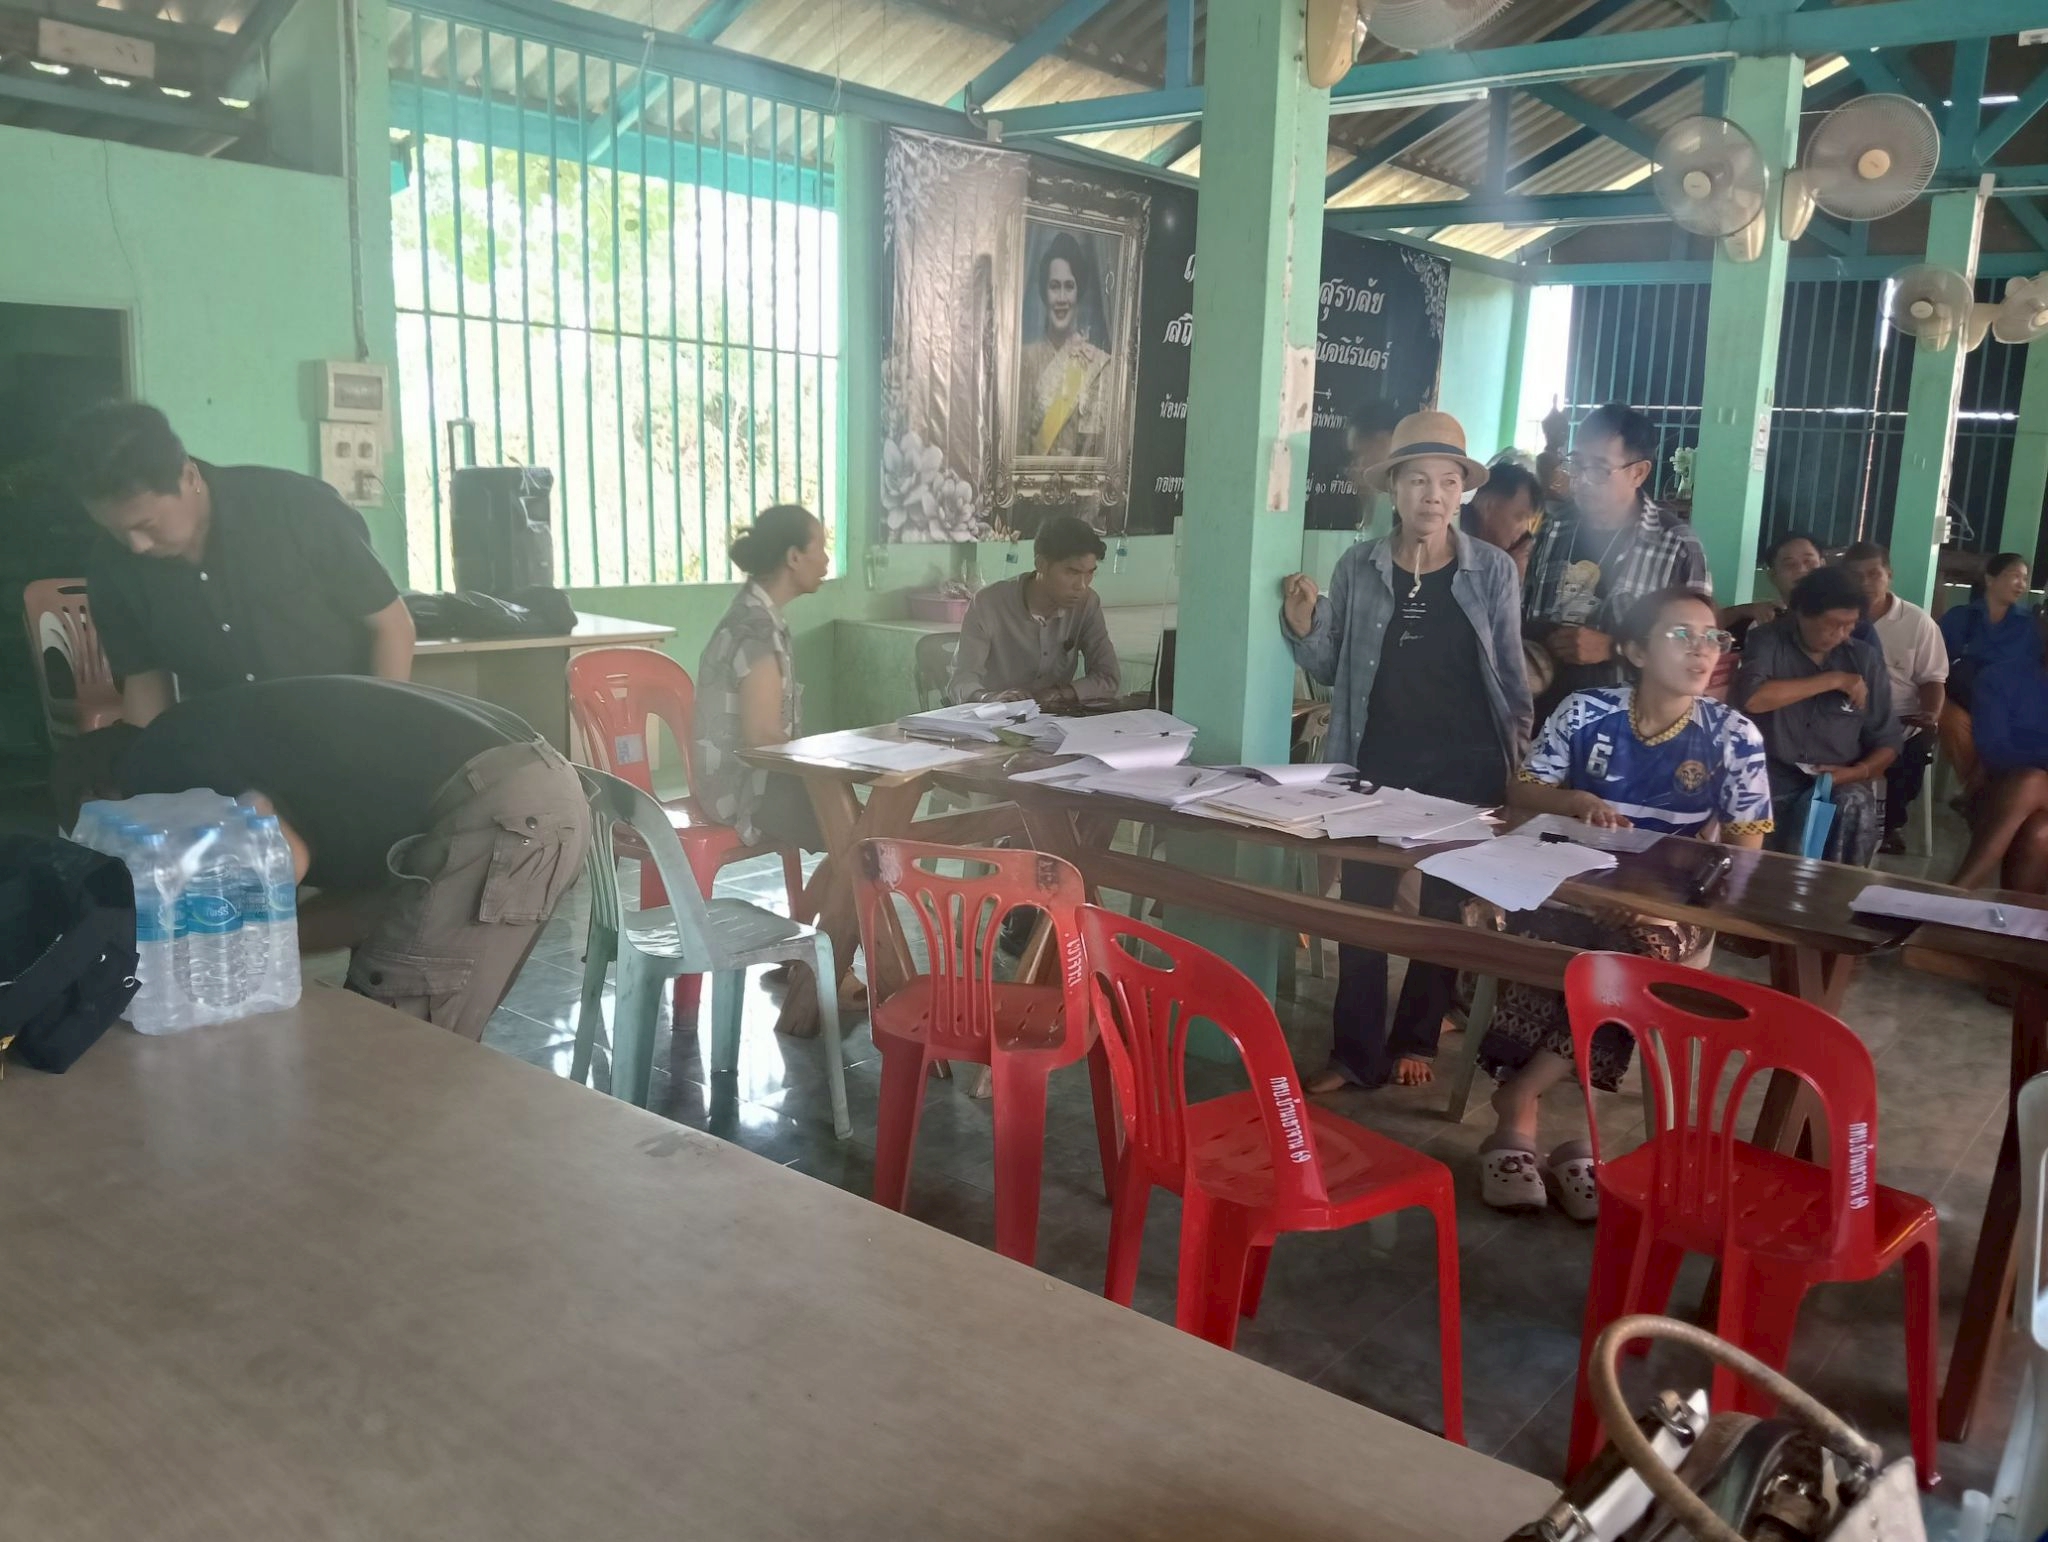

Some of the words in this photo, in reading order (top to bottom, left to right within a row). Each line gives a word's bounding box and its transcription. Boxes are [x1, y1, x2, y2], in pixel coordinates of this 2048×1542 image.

[1162, 312, 1193, 347] สถิ
[1586, 742, 1614, 778] 6
[1290, 1149, 1312, 1164] 69
